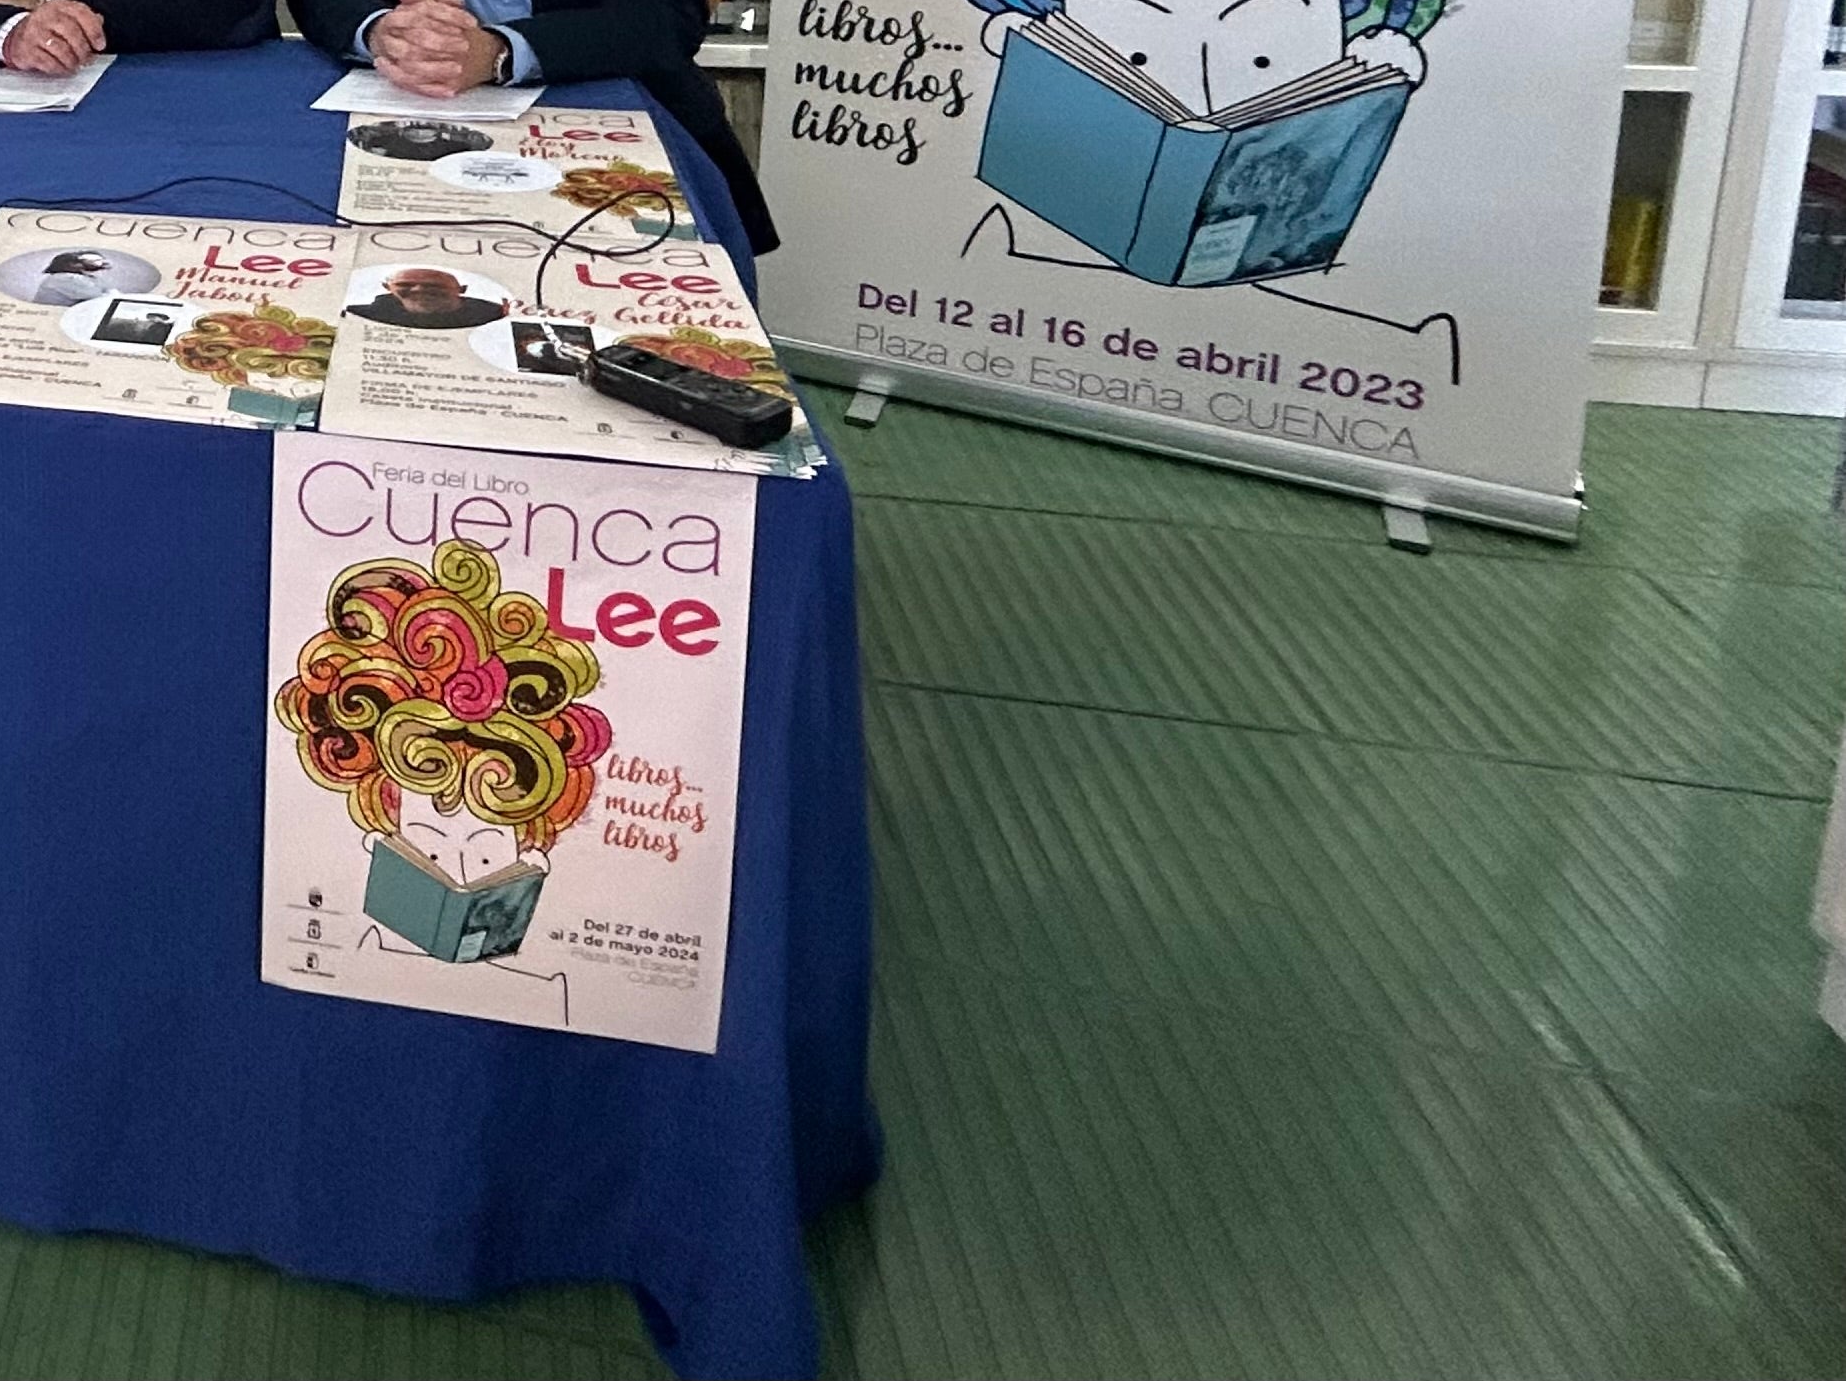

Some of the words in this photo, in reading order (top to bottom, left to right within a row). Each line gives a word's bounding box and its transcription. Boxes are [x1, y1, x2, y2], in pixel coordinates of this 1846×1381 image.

[795, 59, 974, 118] muchos
[528, 124, 643, 143] Lee
[791, 100, 927, 165] libros
[35, 212, 336, 252] Cuenca
[174, 266, 303, 291] Manuel
[203, 244, 334, 277] Lee
[575, 263, 722, 294] Lee
[165, 281, 274, 307] Jabois
[614, 306, 751, 330] Gellida
[856, 282, 917, 319] Del
[934, 296, 974, 328] 12
[989, 308, 1025, 338] al
[1044, 318, 1086, 350] 16
[1101, 325, 1159, 363] de
[1175, 337, 1281, 386] abril
[1298, 360, 1426, 412] 2023
[853, 321, 951, 368] Plaza
[962, 345, 1016, 382] de
[1027, 355, 1185, 416] España
[1207, 390, 1421, 462] CUENCA
[500, 410, 569, 422] CUENCA
[371, 460, 427, 486] Feria
[432, 467, 467, 491] del
[472, 470, 530, 496] Libro
[297, 460, 722, 577] Cuenca
[546, 566, 721, 657] Lee
[606, 753, 705, 796] libros...
[603, 790, 710, 832] muchos
[602, 819, 683, 862] libros
[549, 930, 564, 941] al
[569, 932, 579, 943] 2
[583, 934, 603, 948] de
[608, 941, 654, 956] mayo
[657, 946, 700, 961] 2024
[584, 918, 610, 934] Del
[614, 923, 634, 937] 27
[638, 927, 659, 942] de
[664, 932, 702, 948] abril
